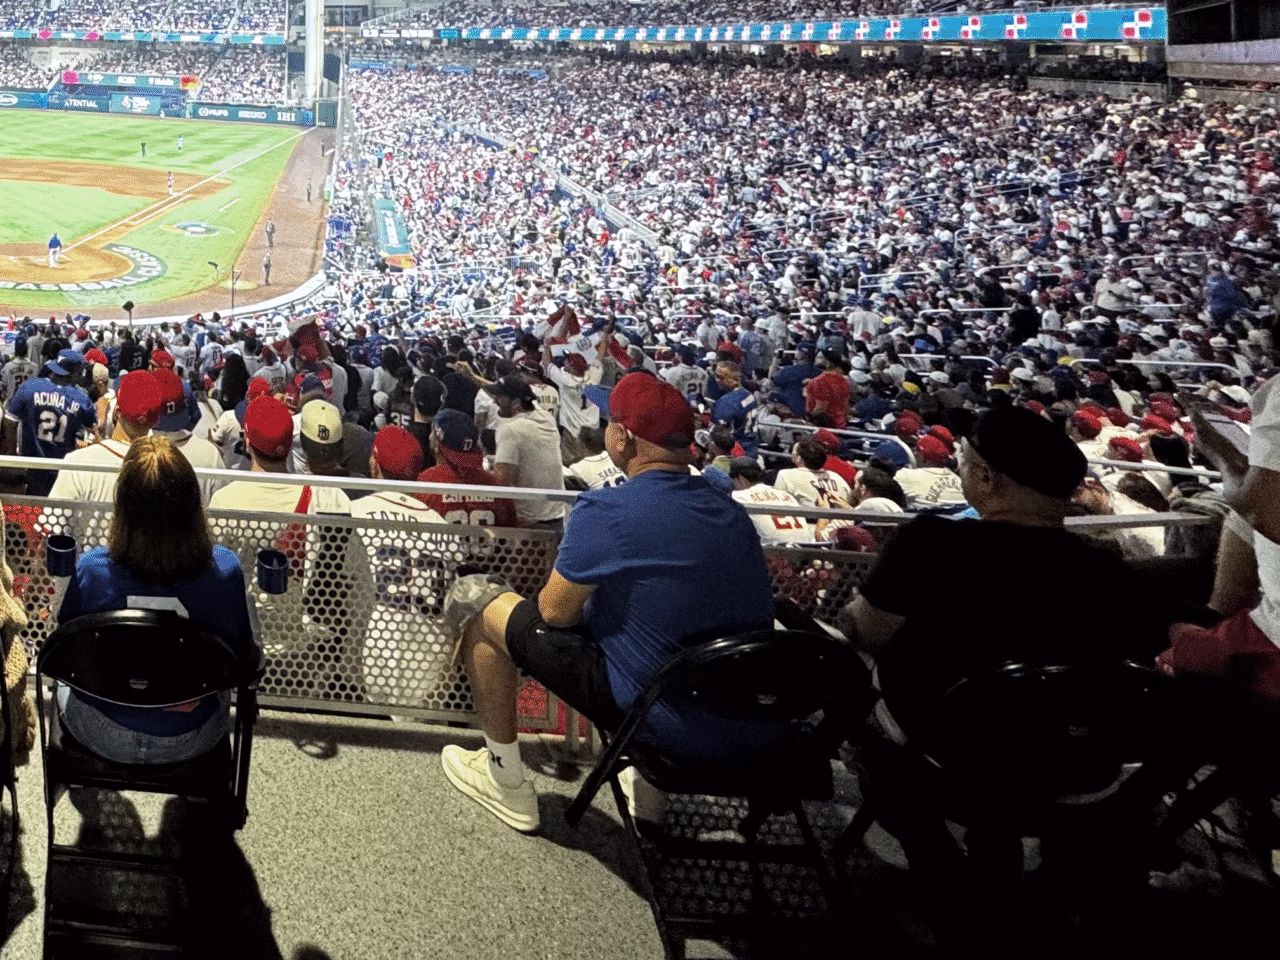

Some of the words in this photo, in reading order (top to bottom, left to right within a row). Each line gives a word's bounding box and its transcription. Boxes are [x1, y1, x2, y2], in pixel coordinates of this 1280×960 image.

[33, 391, 66, 409] ACUÑA
[37, 410, 68, 443] 21
[390, 412, 412, 426] 35
[810, 478, 839, 492] SOTO
